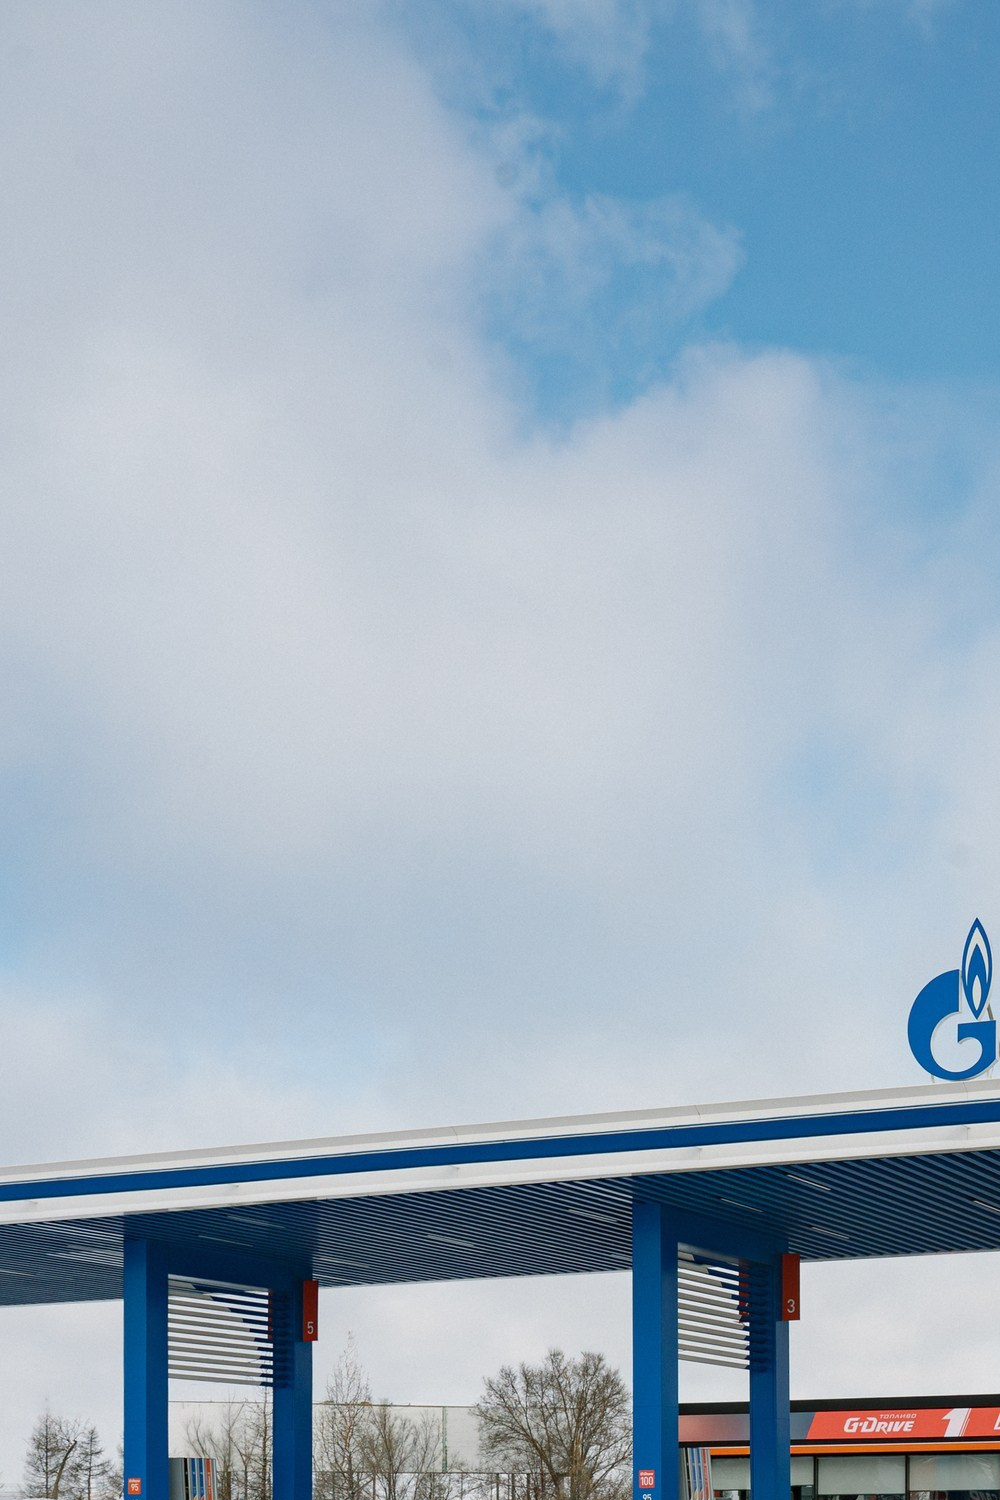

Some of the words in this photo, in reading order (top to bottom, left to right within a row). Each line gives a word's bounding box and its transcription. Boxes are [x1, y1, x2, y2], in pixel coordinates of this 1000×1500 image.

[786, 1298, 796, 1314] 3
[307, 1321, 314, 1335] 5
[640, 1476, 654, 1486] 100
[130, 1483, 139, 1492] 95
